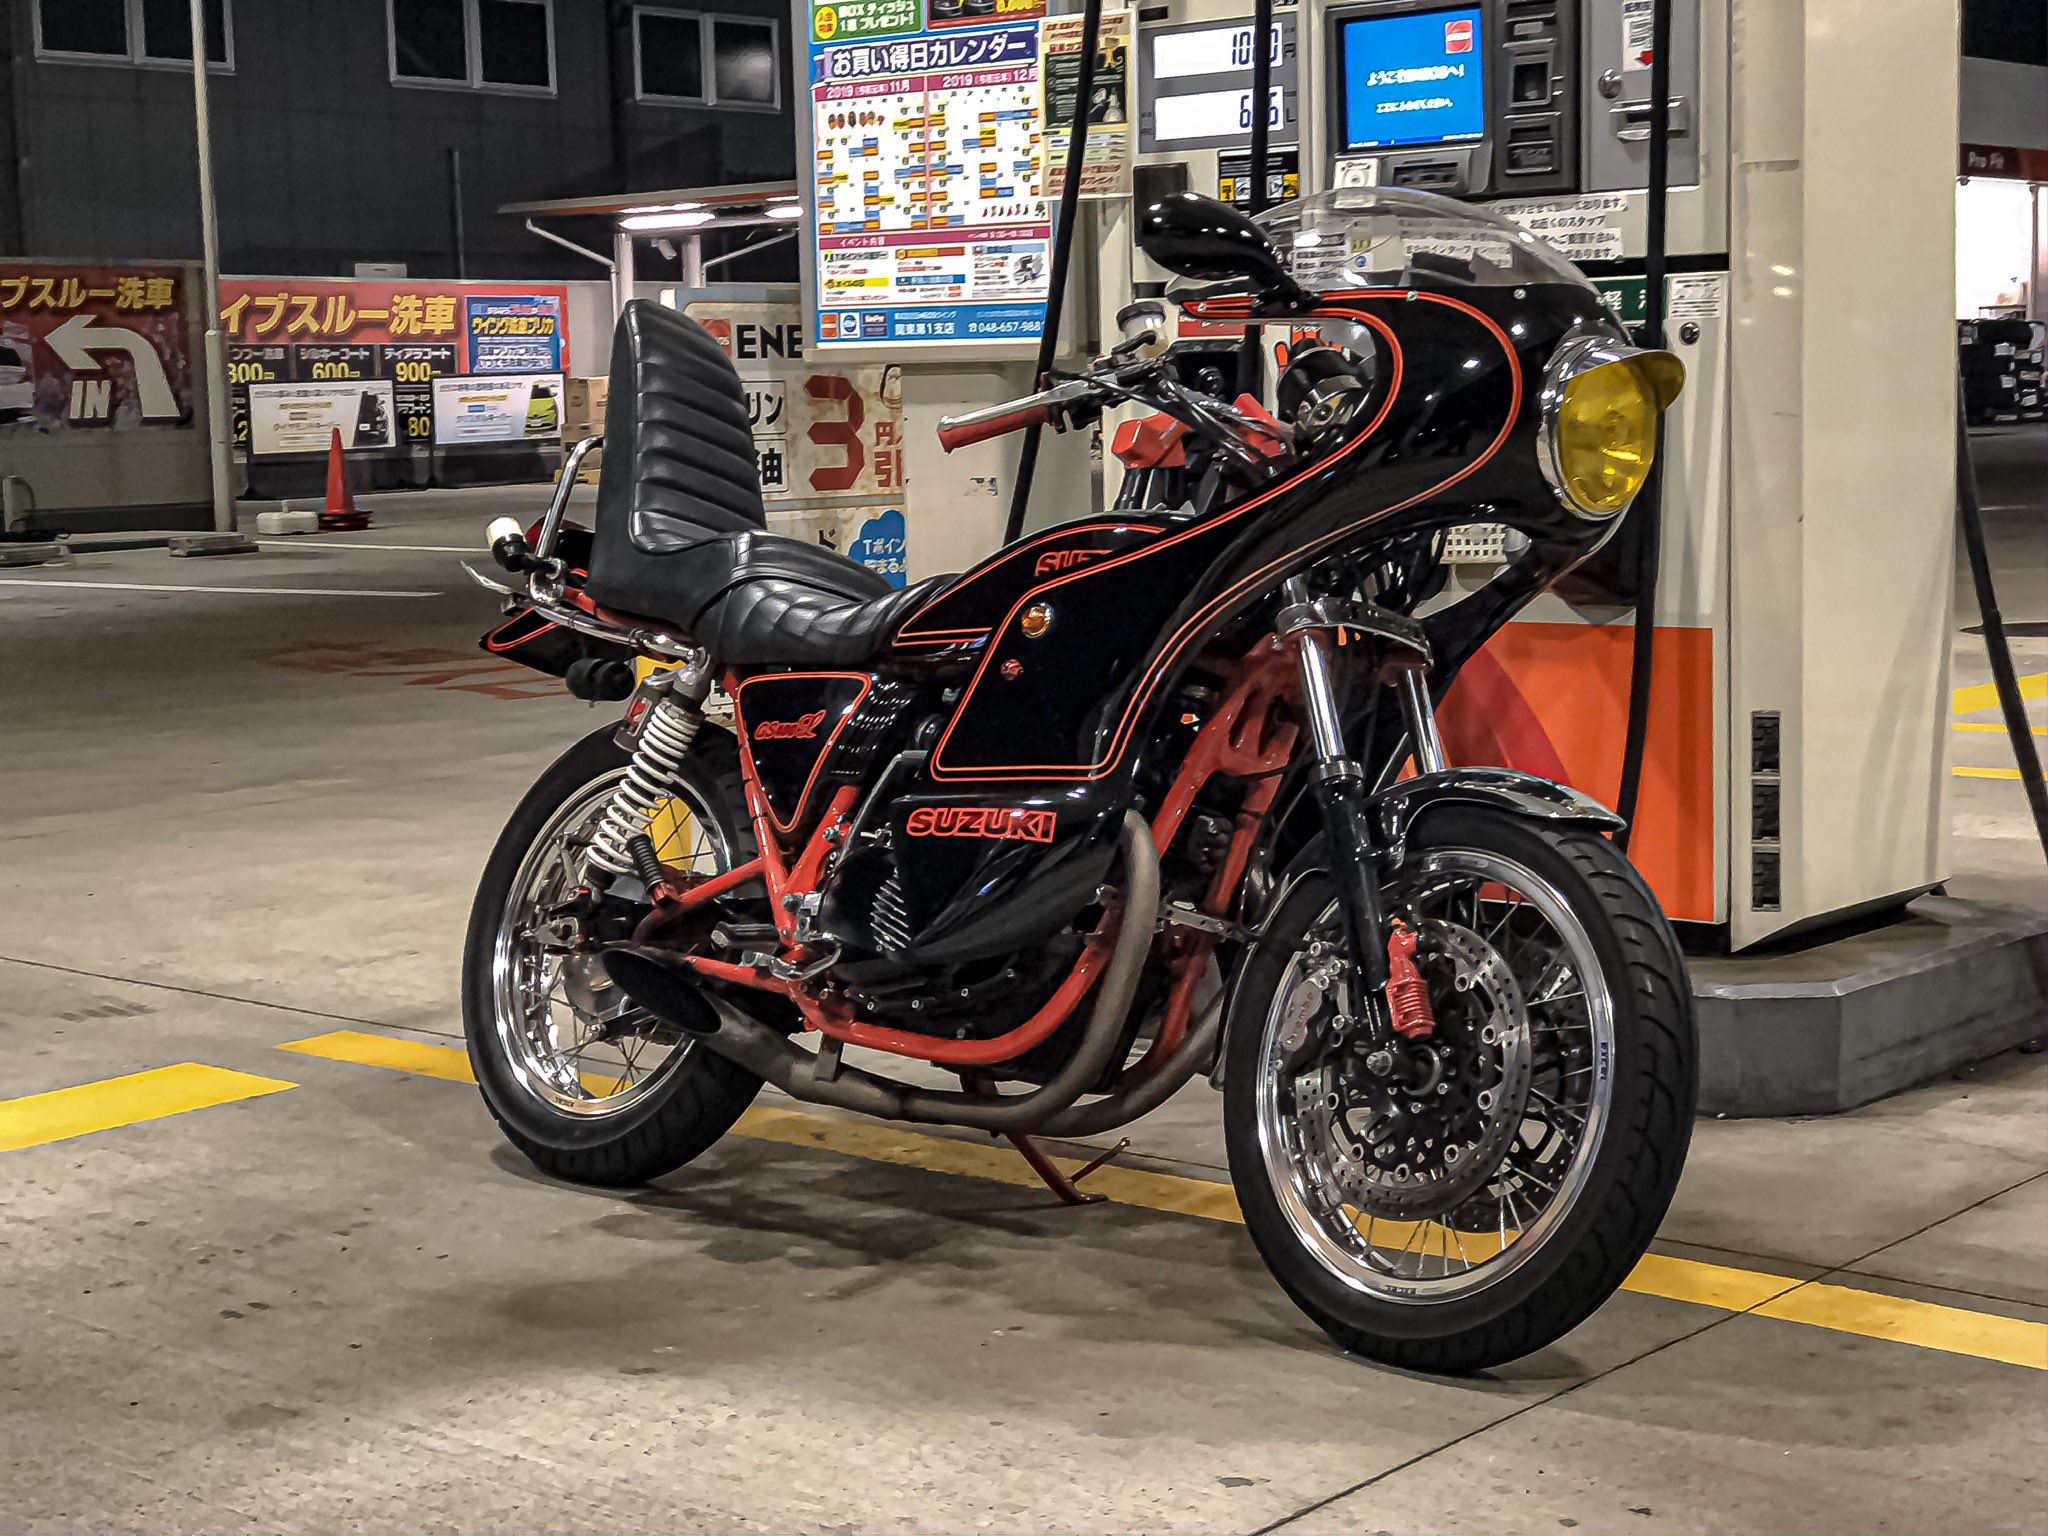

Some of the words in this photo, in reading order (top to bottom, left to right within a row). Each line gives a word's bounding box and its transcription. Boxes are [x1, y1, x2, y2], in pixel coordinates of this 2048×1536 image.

[832, 31, 1027, 77] お買い得日カレンダー
[942, 74, 973, 88] 2019
[69, 380, 112, 418] IN
[804, 374, 865, 491] 3
[907, 807, 1057, 844] SUZUKI
